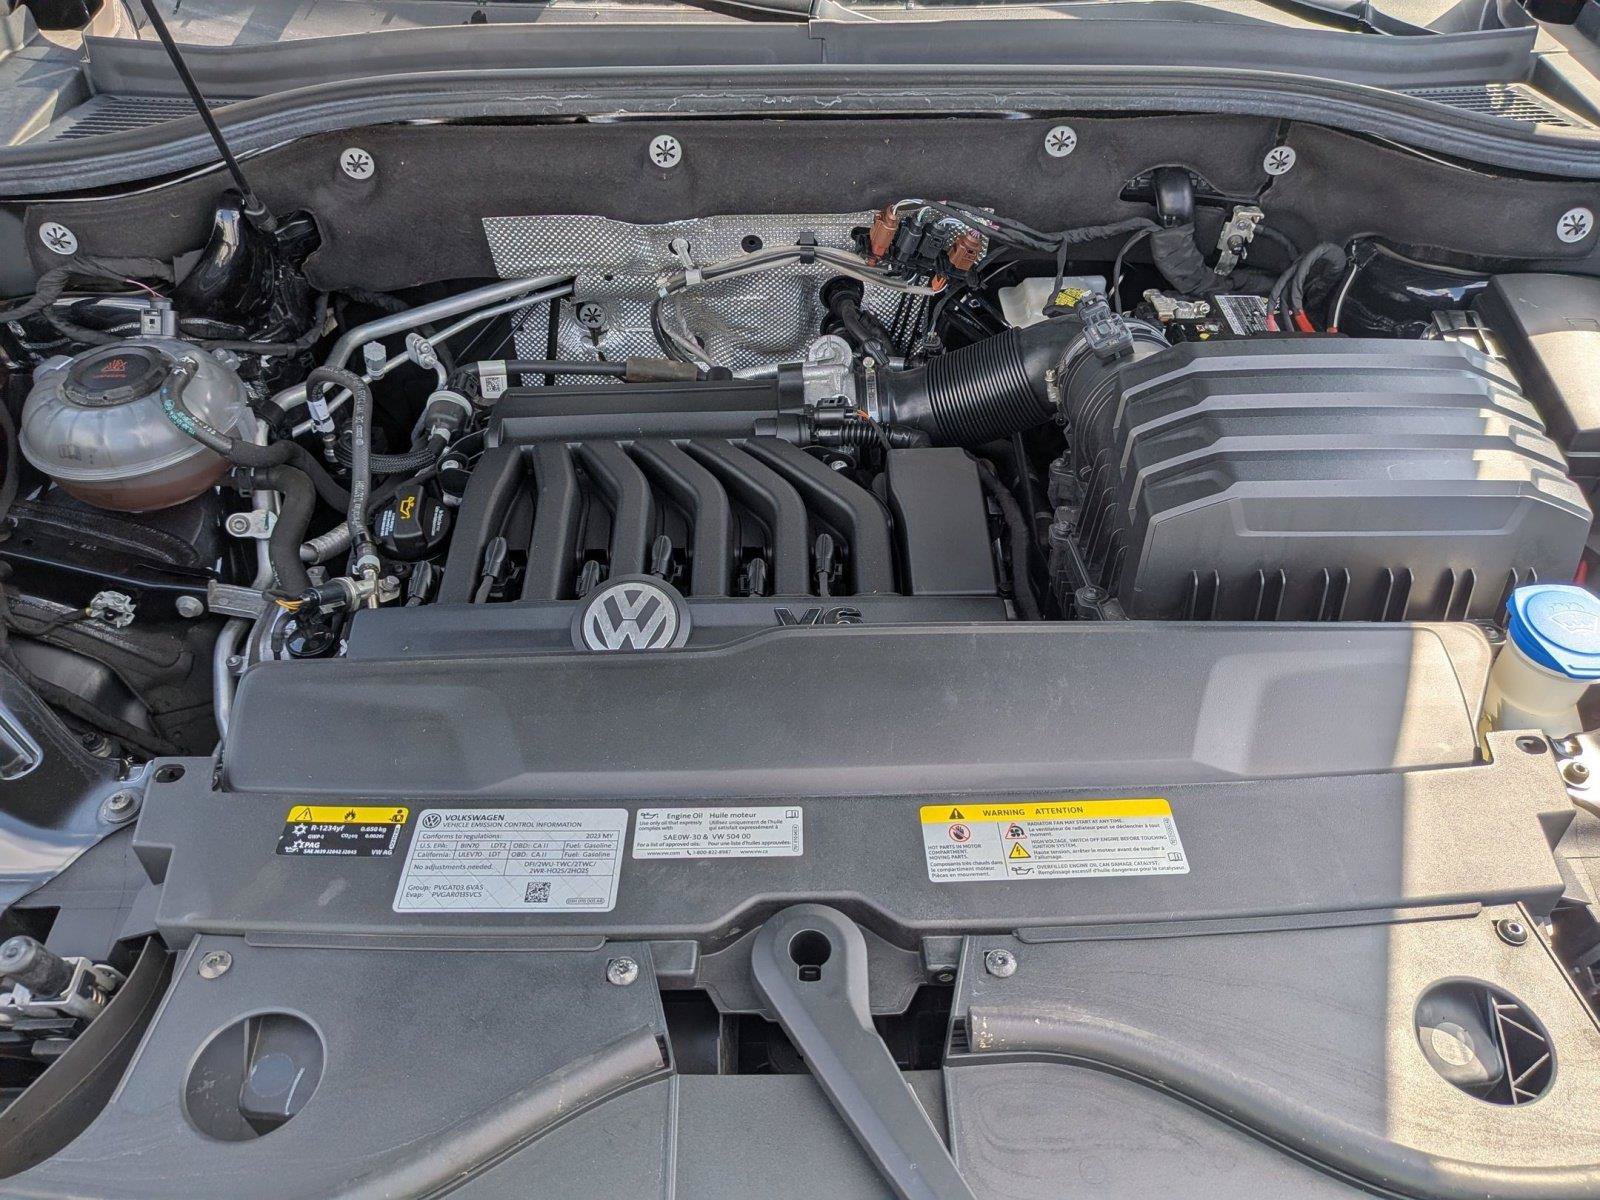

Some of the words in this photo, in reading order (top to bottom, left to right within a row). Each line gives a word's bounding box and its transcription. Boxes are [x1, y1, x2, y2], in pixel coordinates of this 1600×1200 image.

[982, 809, 1025, 817] WARNING
[1035, 807, 1084, 815] ATTENTION
[310, 825, 346, 833] R-1234yf
